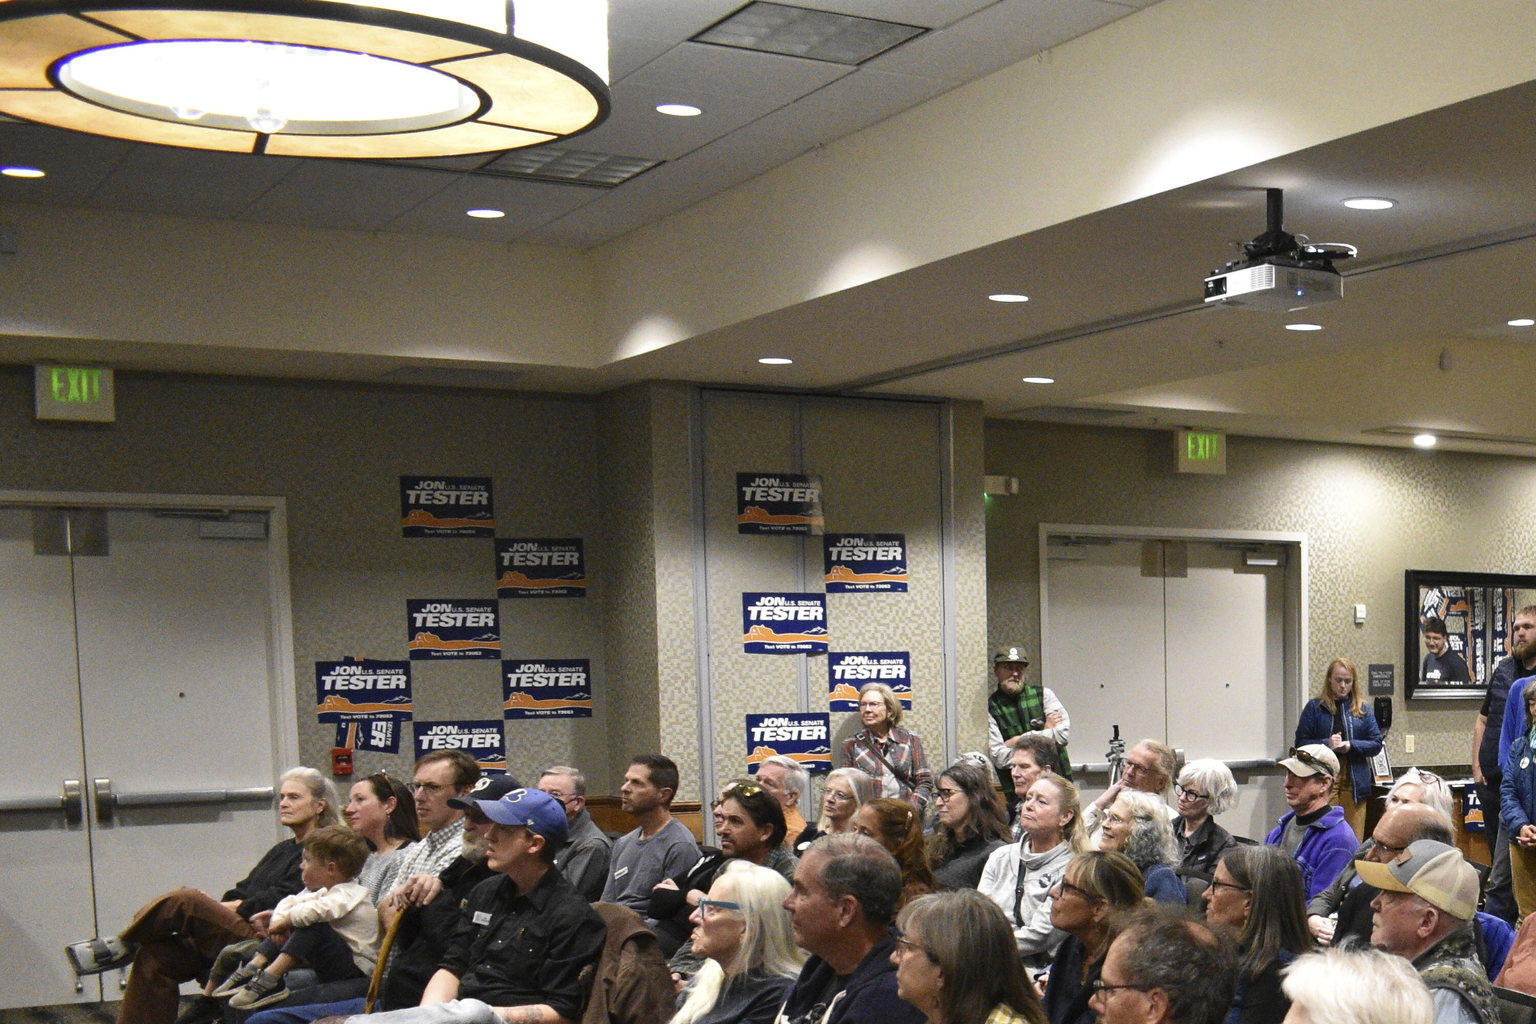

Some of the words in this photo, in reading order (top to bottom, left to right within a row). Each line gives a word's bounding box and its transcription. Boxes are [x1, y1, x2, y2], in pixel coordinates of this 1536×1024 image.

[51, 368, 102, 403] EXIT
[1187, 433, 1219, 460] EXIT
[414, 480, 445, 490] JON
[750, 477, 779, 487] JON
[406, 490, 489, 505] TESTER
[742, 487, 820, 503] TESTER
[508, 542, 537, 552] JON
[836, 538, 864, 546] JON
[500, 552, 580, 566] TESTER
[829, 547, 902, 561] TESTER
[421, 603, 452, 613] JON
[755, 596, 785, 606] JON
[413, 613, 495, 628] TESTER
[747, 606, 824, 621] TESTER
[840, 656, 868, 665] JON
[330, 666, 362, 675] JON
[515, 664, 545, 673] JON
[832, 665, 906, 679] TESTER
[321, 675, 407, 691] TESTER
[507, 673, 586, 688] TESTER
[759, 718, 789, 727] JON
[427, 725, 457, 735] JON
[751, 726, 827, 742] TESTER
[419, 734, 501, 750] TESTER
